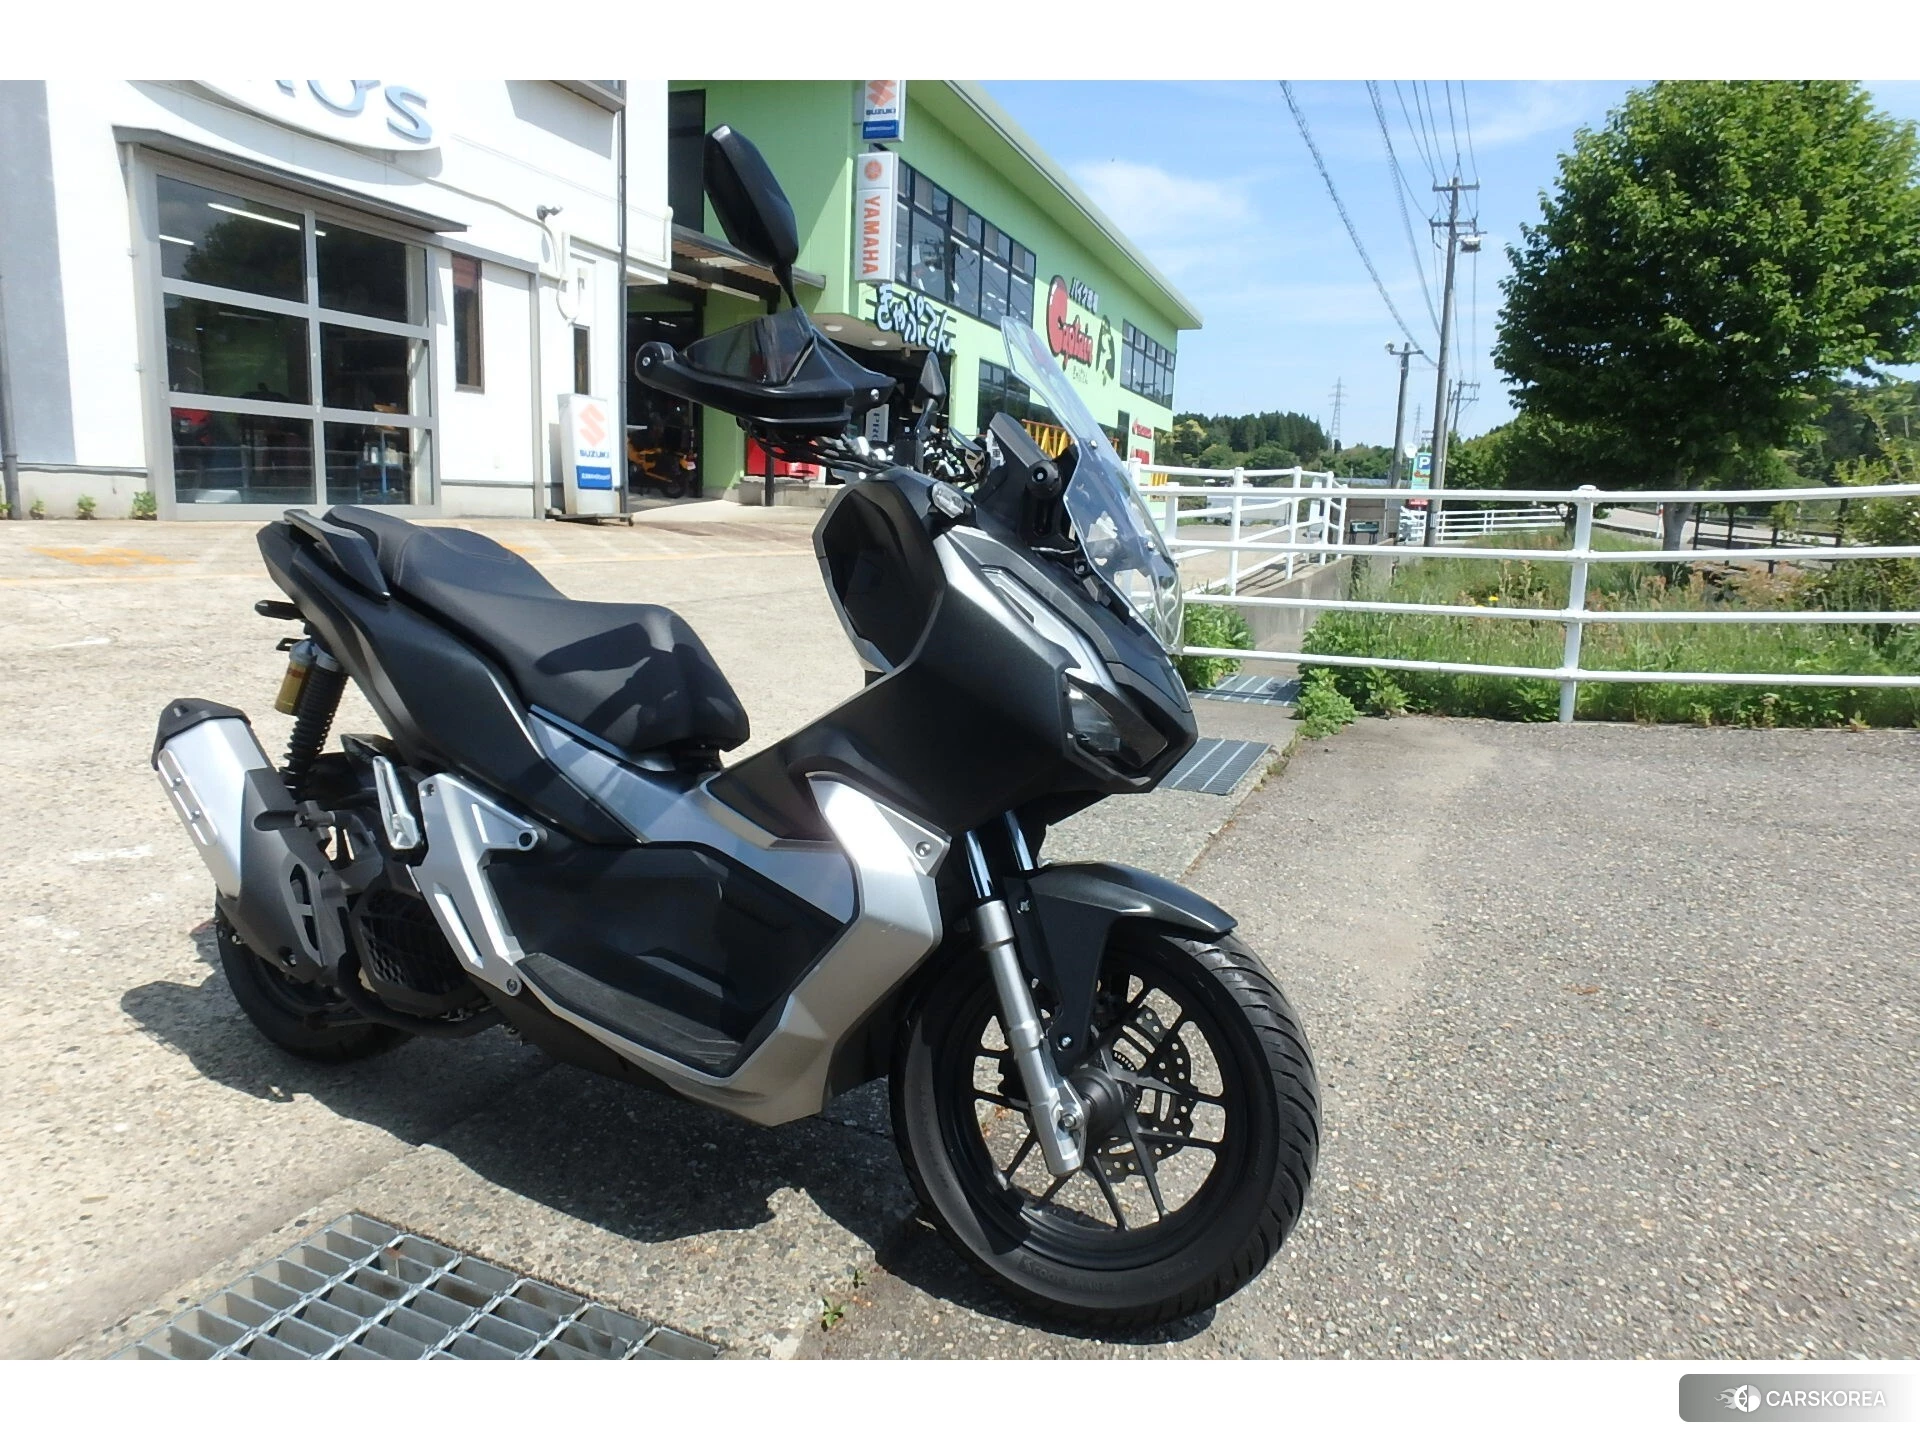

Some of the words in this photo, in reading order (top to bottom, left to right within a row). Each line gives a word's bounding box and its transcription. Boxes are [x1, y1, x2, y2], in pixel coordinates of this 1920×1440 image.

[863, 195, 880, 274] YAMAHA
[876, 283, 953, 355] きゃぷてん
[580, 449, 610, 459] SUZUKI
[1419, 456, 1430, 468] P
